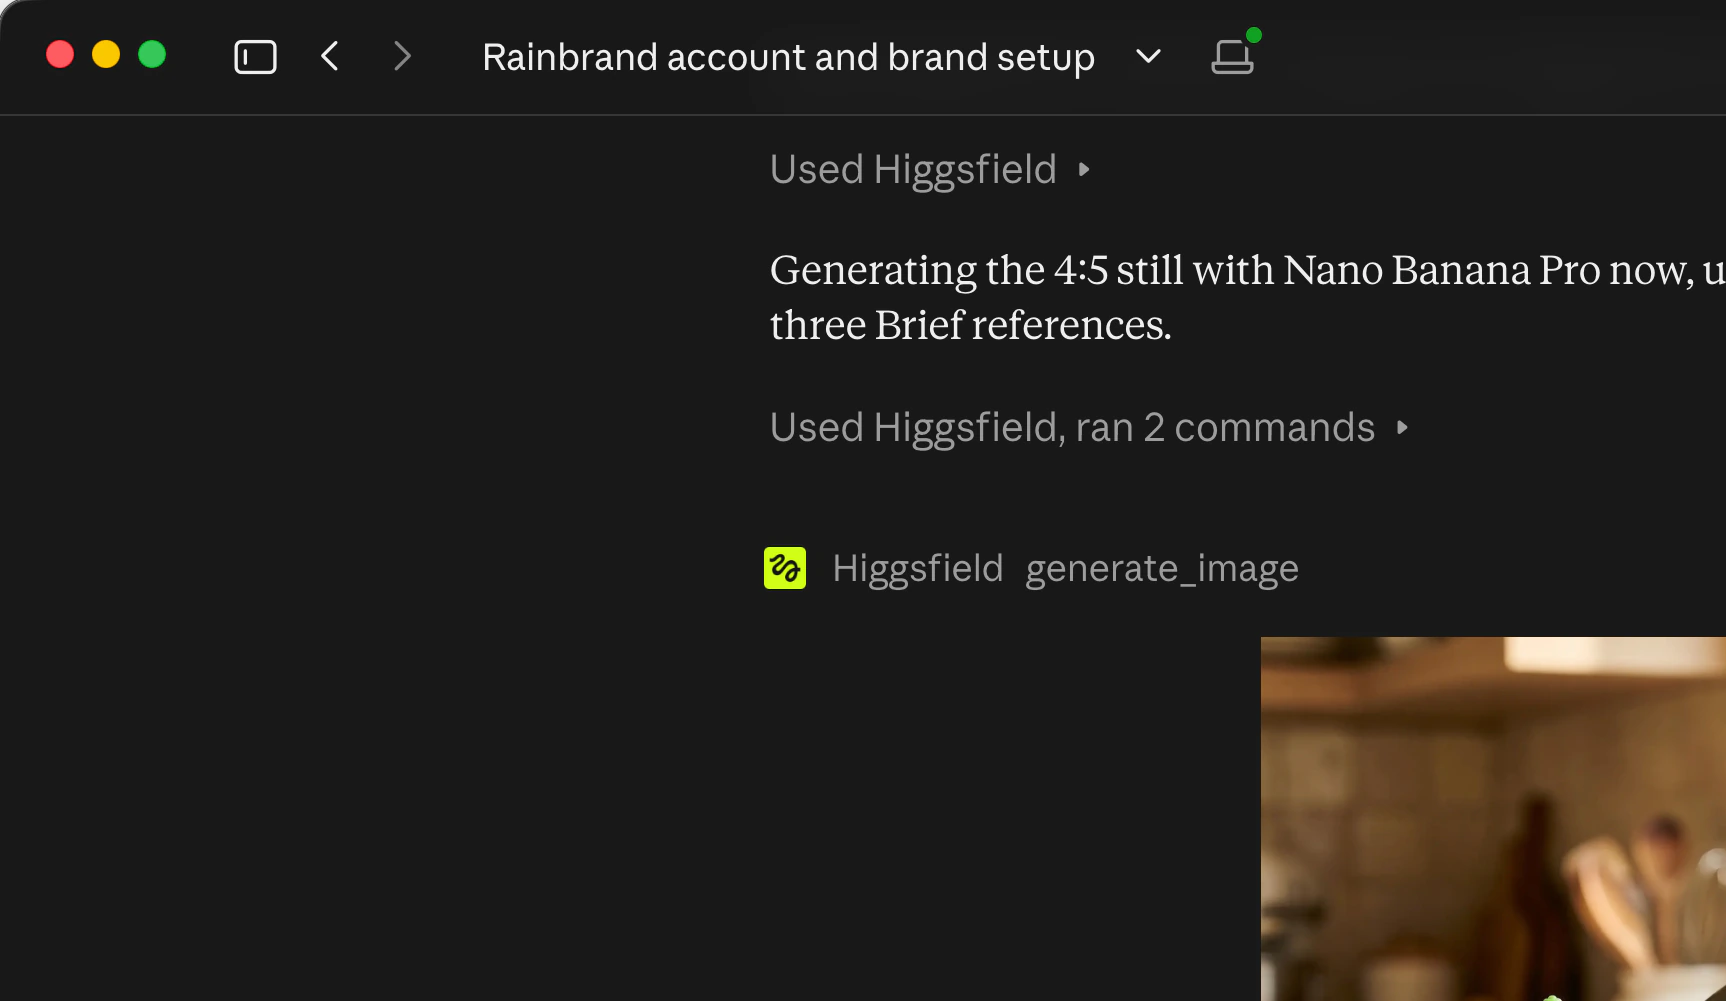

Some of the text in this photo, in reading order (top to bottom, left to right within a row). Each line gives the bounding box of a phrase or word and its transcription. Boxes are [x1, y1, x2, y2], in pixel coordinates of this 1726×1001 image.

[485, 42, 1095, 79] Rainbrand account and brand setup
[772, 153, 1055, 193] Used Higgsfield
[771, 254, 977, 294] Generating
[986, 254, 1044, 285] the
[1054, 255, 1108, 285] 4:5
[1118, 254, 1183, 285] still
[1192, 254, 1275, 285] with
[1284, 255, 1383, 285] Nano
[1392, 255, 1531, 285] Banana
[1540, 255, 1600, 285] Pro
[1610, 262, 1694, 290] now,
[770, 309, 1171, 340] three Brief references.
[772, 411, 1375, 451] Used Higgsfield, ran 2 commands
[835, 553, 1298, 590] Higgsfield generate_image
